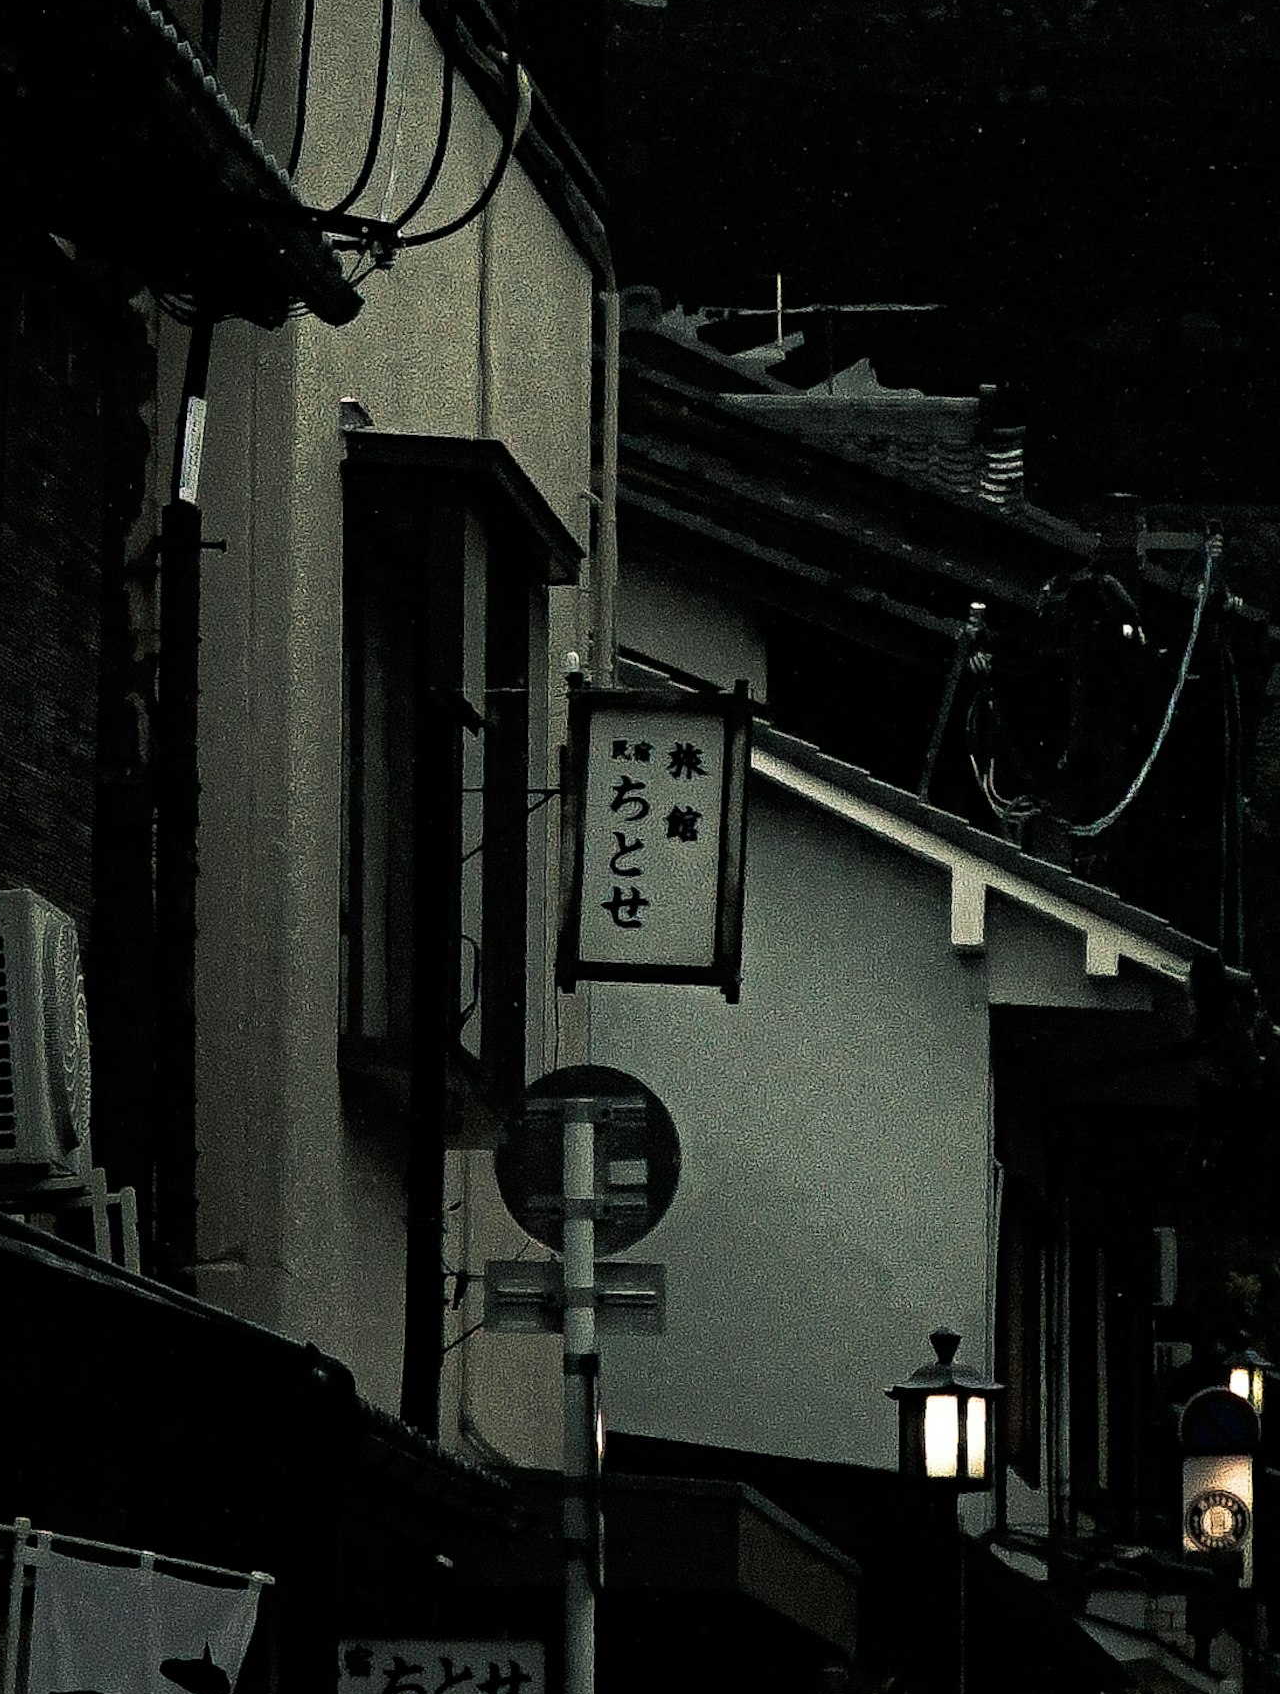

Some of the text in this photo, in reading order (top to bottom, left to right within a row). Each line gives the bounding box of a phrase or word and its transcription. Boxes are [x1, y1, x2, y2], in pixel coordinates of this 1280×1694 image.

[611, 739, 654, 763] 民宿
[666, 742, 708, 843] 旅館
[601, 774, 651, 929] ちとせ
